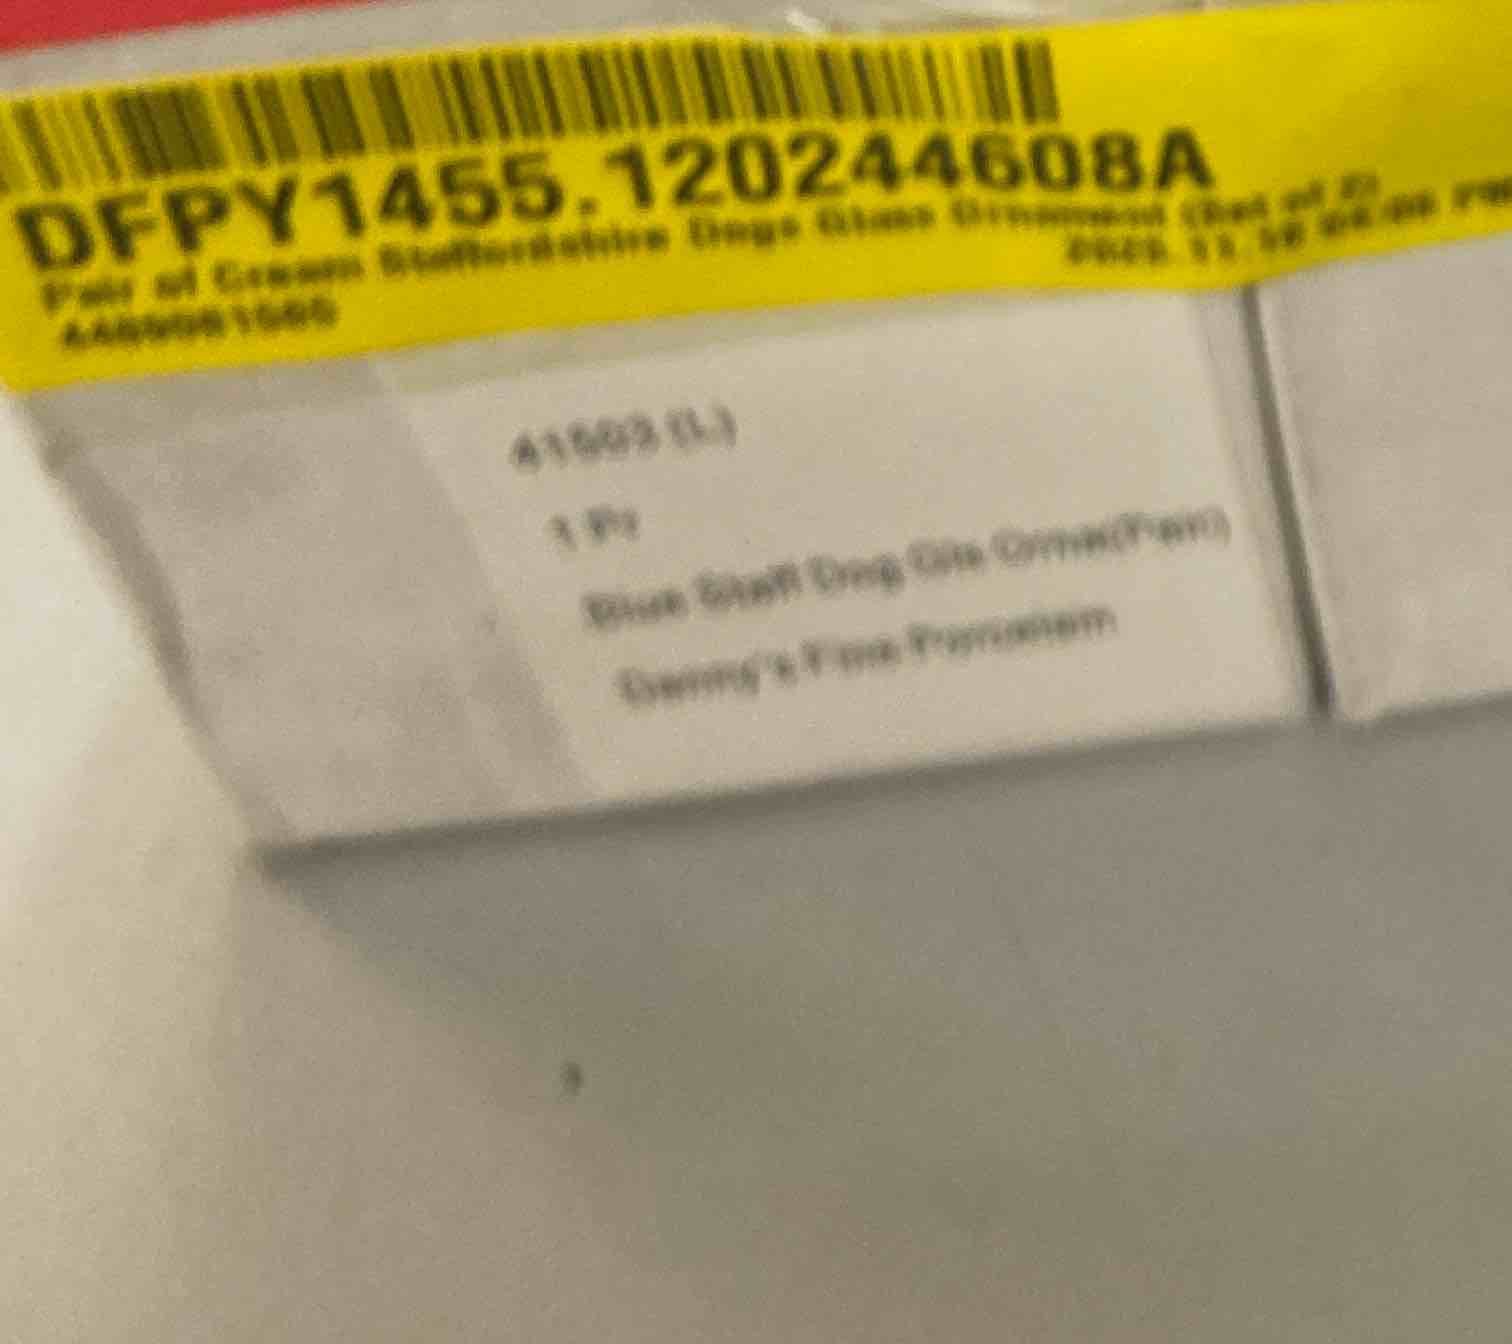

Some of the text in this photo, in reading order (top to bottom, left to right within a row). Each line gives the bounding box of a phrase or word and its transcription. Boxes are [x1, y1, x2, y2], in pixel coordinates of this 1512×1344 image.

[14, 125, 1216, 270] DFPY1455.120244608A
[40, 277, 134, 316] Pair
[154, 261, 199, 301] of
[211, 254, 366, 294] Cream
[378, 224, 669, 280] Staffordshire
[689, 214, 801, 252] Dogs
[948, 196, 1167, 232] Ornament
[507, 405, 737, 474] 41503 (L)
[581, 586, 690, 631] Blue
[691, 559, 802, 615] Staff
[804, 552, 906, 596] Dog
[614, 603, 1118, 707] Danny's Fine Porcelain
